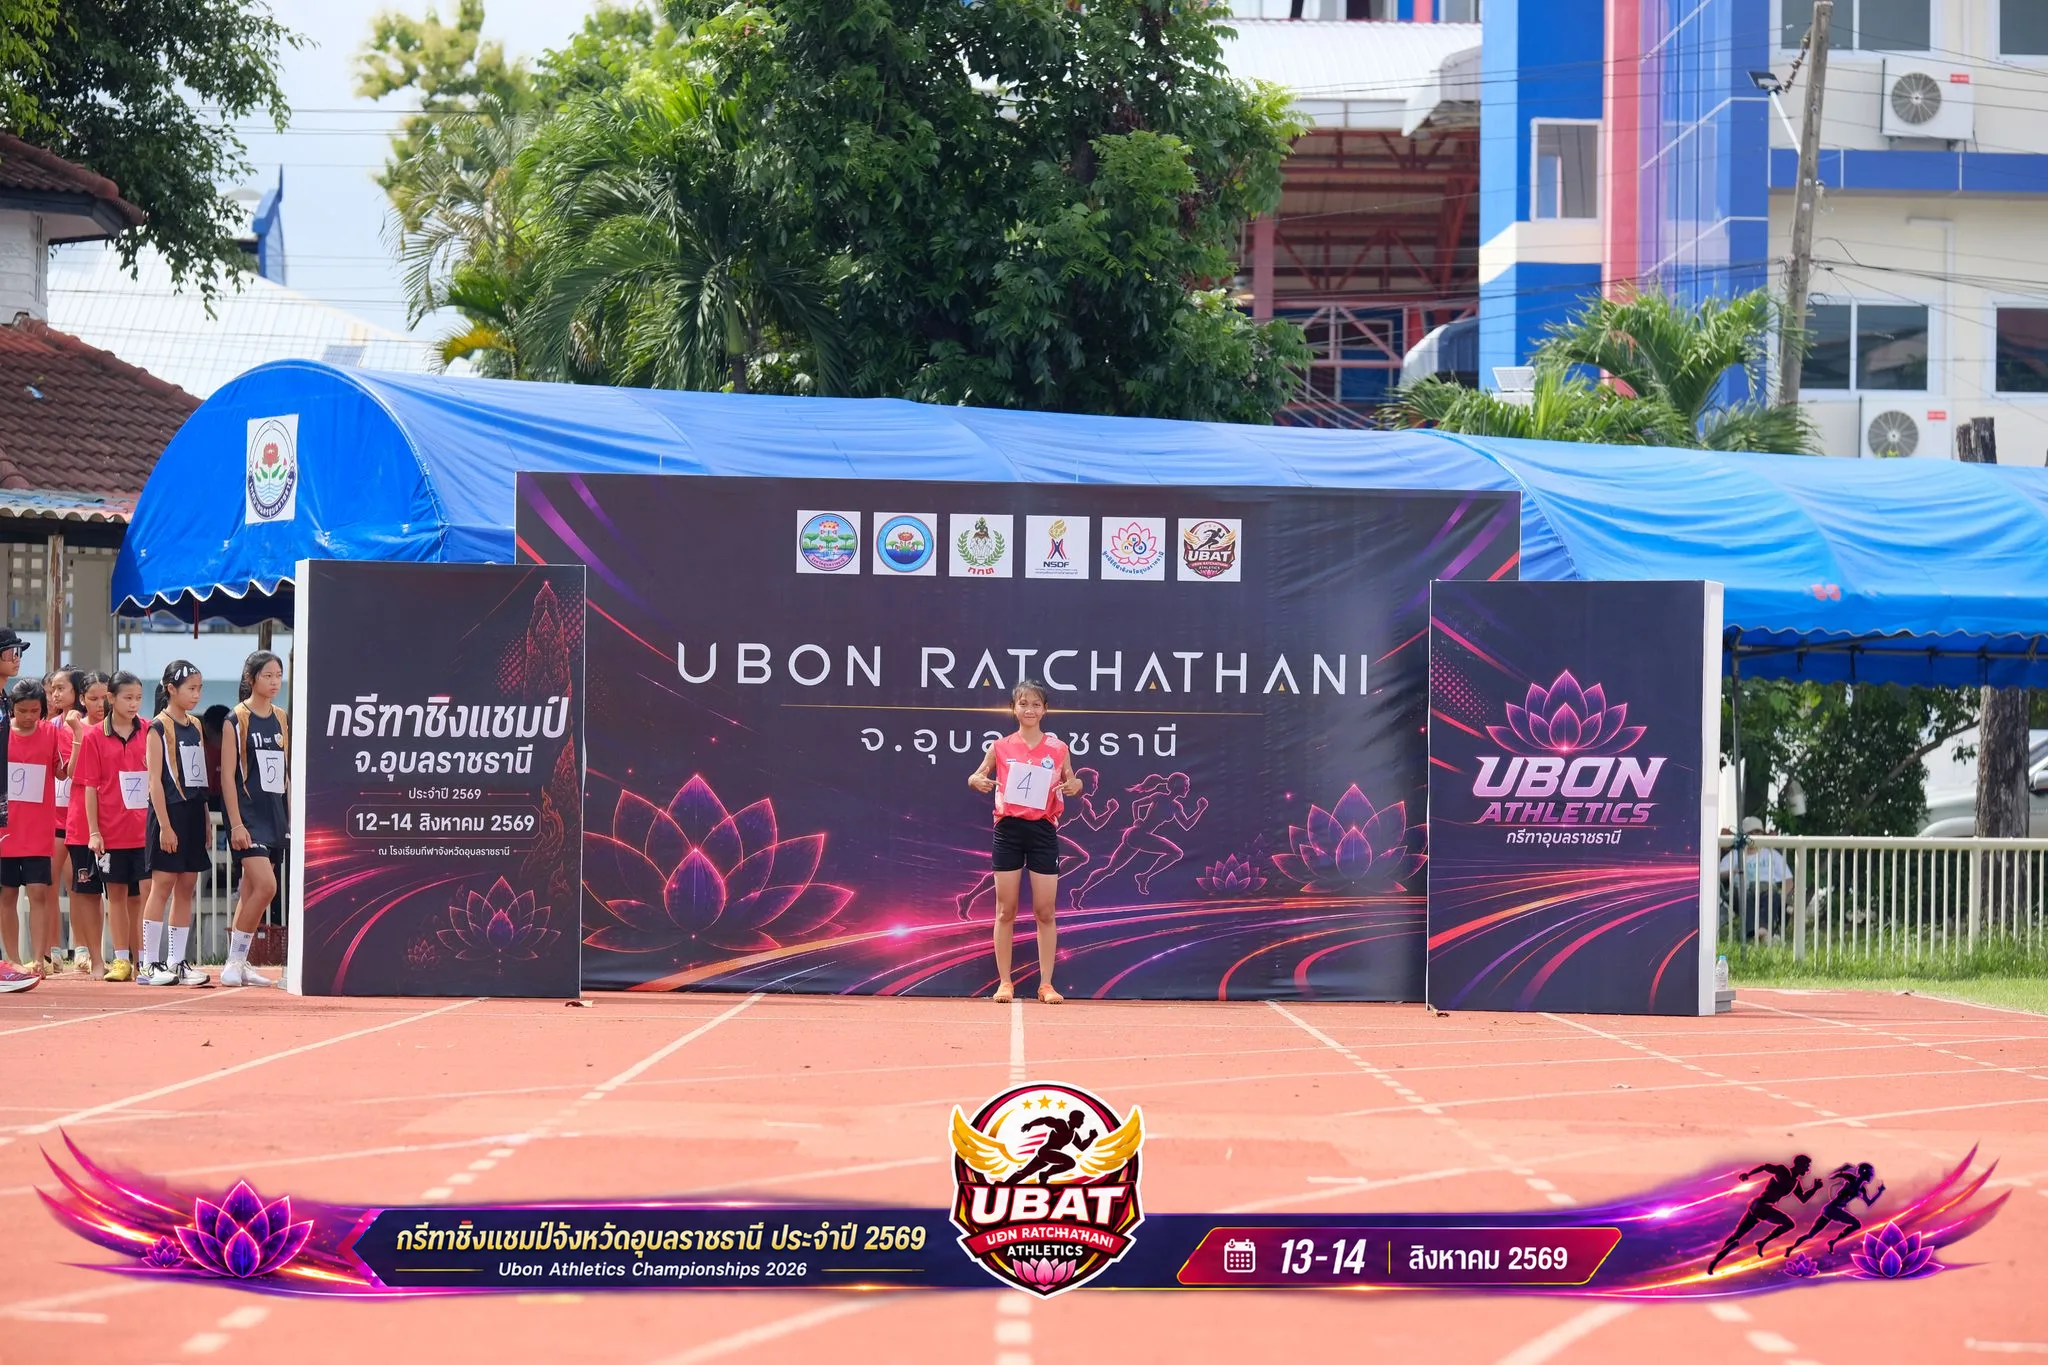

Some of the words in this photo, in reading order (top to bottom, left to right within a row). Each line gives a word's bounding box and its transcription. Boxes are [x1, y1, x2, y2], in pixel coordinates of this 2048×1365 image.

[1188, 551, 1231, 562] UBAT
[677, 642, 880, 687] UBON
[921, 647, 1368, 696] RATCHATHANI
[327, 694, 570, 739] กรีฑาชิงแชมป์
[252, 732, 263, 748] 11
[191, 751, 201, 778] 6
[265, 757, 279, 784] 5
[355, 744, 533, 782] จ.อุบลราชธานี
[11, 768, 26, 796] 9
[124, 777, 142, 801] 7
[1016, 771, 1032, 799] 4
[1472, 757, 1668, 798] UBON
[408, 787, 448, 800] ประจำปี
[453, 788, 482, 800] 2569
[420, 813, 484, 832] สิงหาคม
[490, 815, 535, 832] 2569
[1476, 802, 1658, 824] ATHLETICS
[1506, 828, 1622, 848] กรีฑาอุบลราชธานี
[378, 848, 388, 856] ณ
